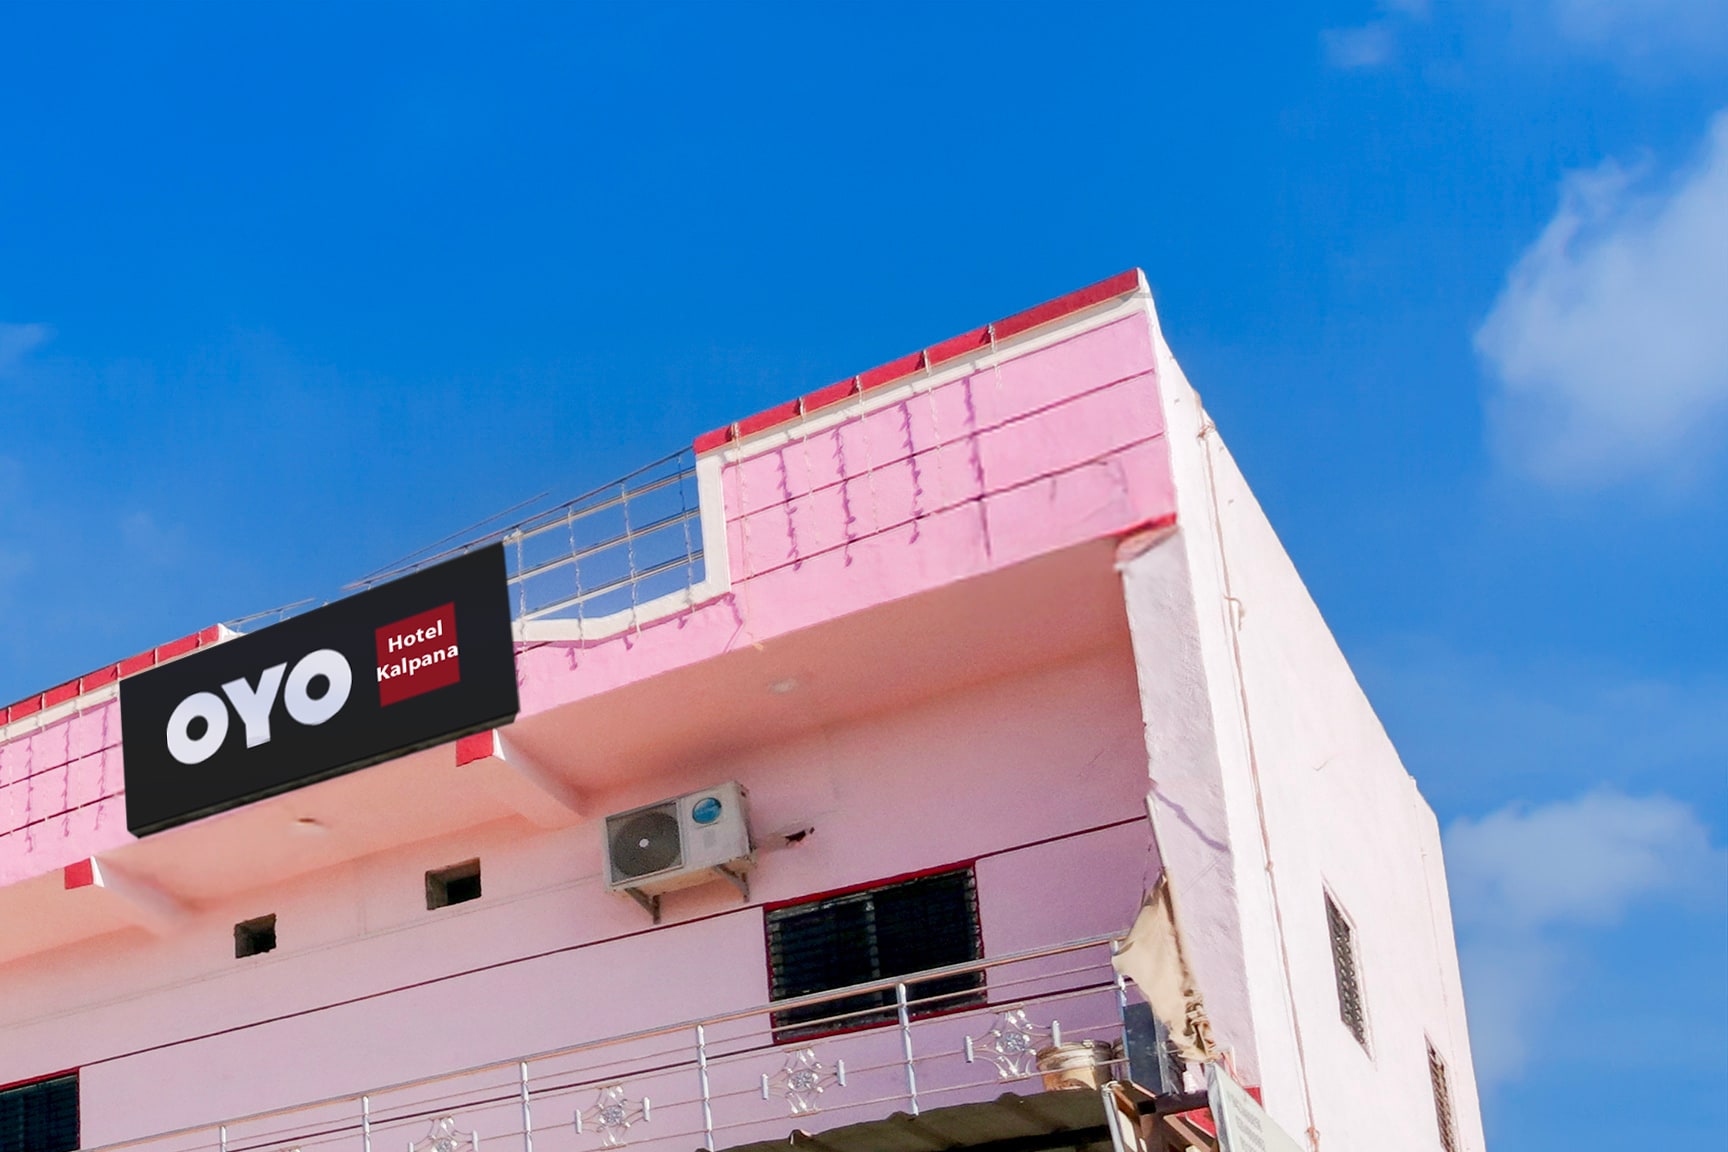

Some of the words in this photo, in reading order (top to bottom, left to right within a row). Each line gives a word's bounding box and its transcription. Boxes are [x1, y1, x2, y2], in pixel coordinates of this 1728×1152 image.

[388, 619, 443, 653] Hotel
[376, 645, 459, 682] Kalpana
[167, 649, 352, 764] OYO
